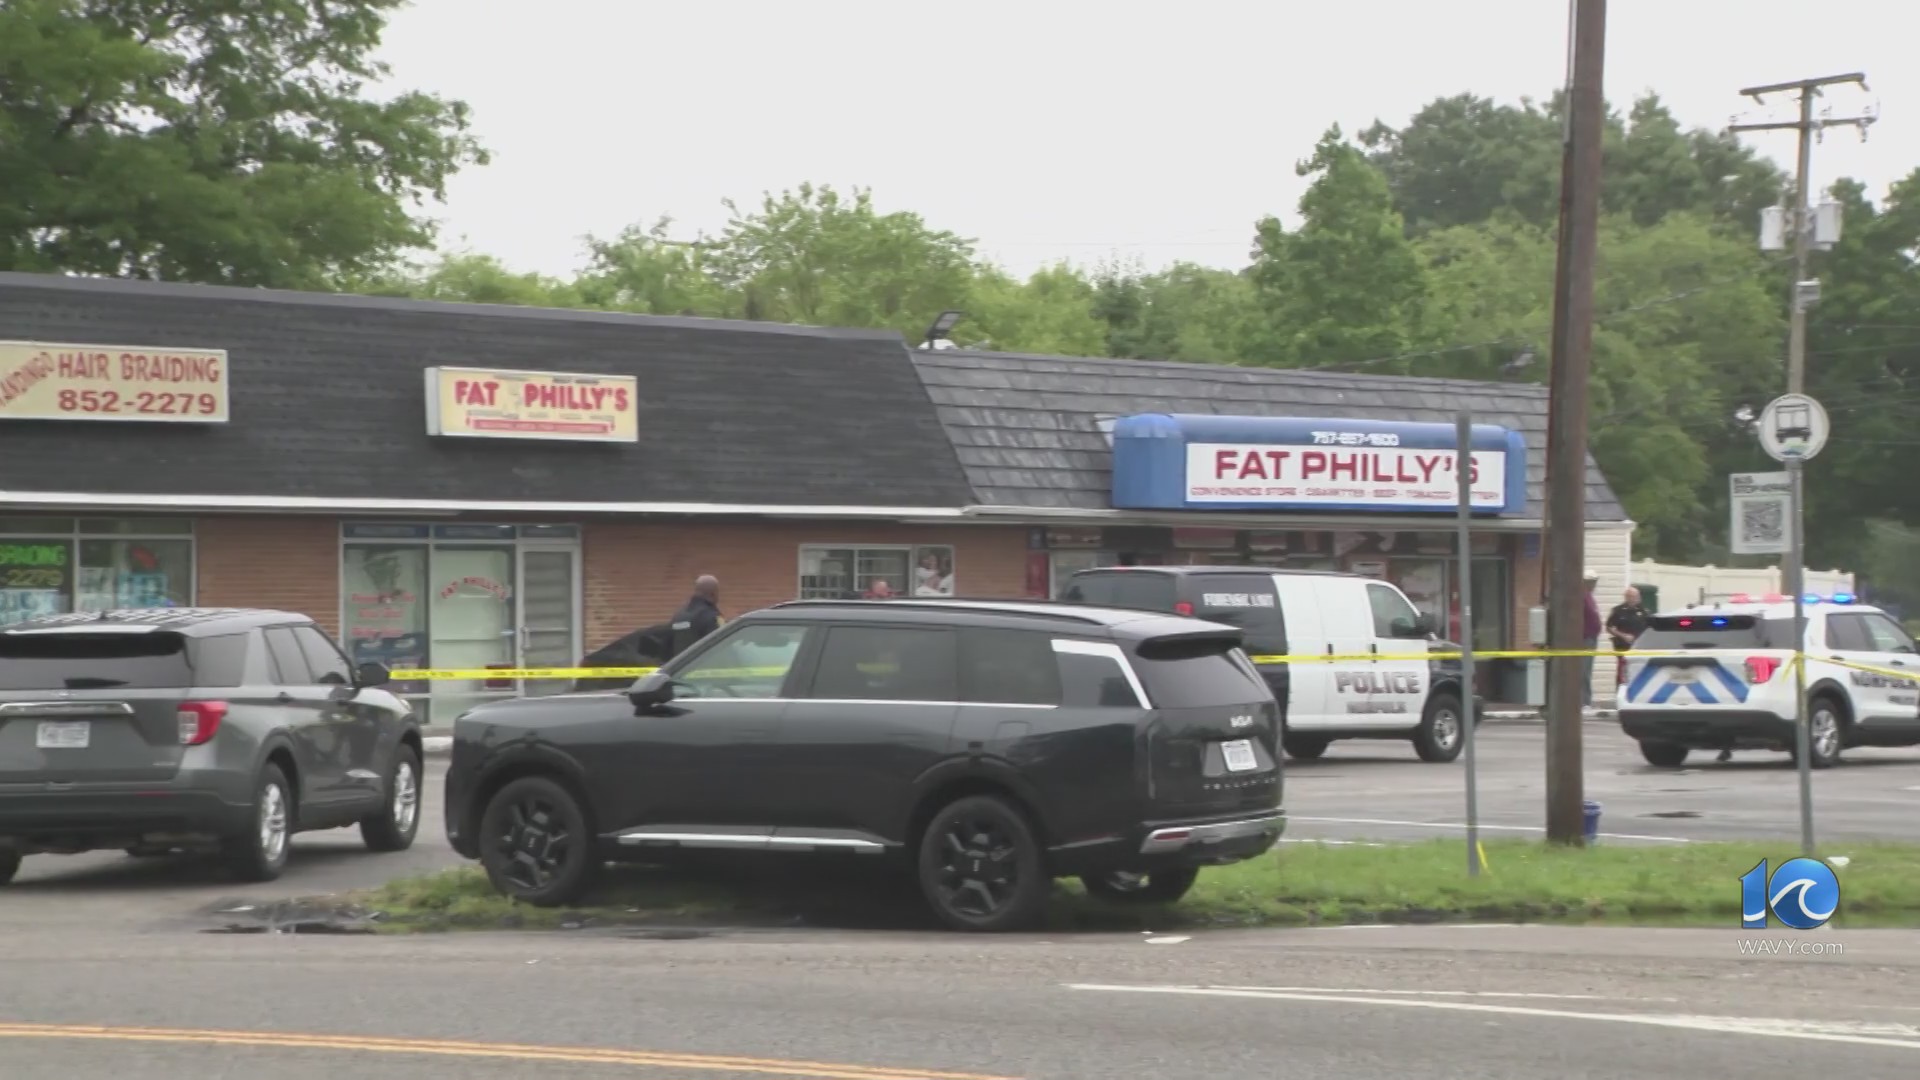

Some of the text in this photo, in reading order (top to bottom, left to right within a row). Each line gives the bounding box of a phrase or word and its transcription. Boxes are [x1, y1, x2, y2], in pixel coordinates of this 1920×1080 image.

[58, 352, 220, 382] HAIR BRAIDING
[58, 389, 216, 414] 852-2279
[455, 381, 629, 411] FAT PHILLY'S
[1215, 450, 1479, 484] FAT PHILLY'S
[1334, 671, 1421, 694] POLICE
